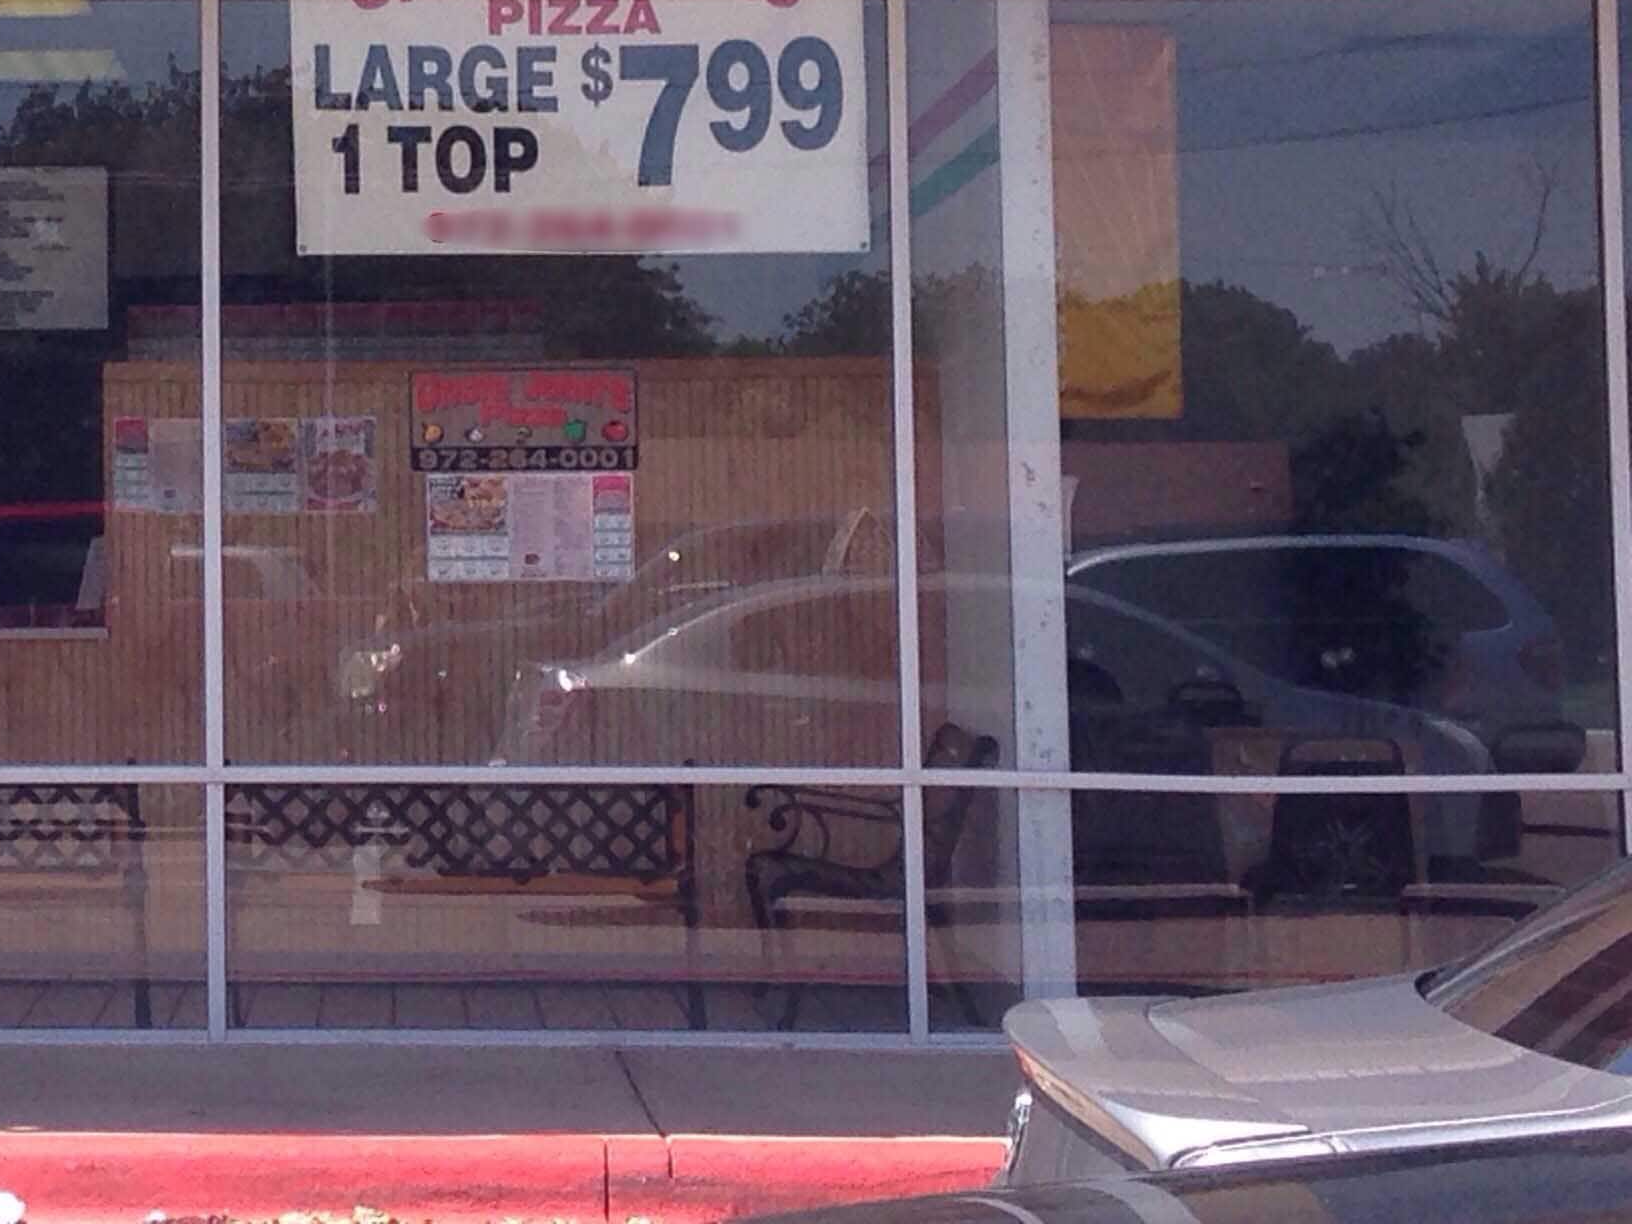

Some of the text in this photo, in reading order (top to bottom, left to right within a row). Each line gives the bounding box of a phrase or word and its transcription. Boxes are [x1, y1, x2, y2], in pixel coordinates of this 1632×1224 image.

[314, 44, 558, 111] LARGE
[332, 125, 539, 194] 1 TOP
